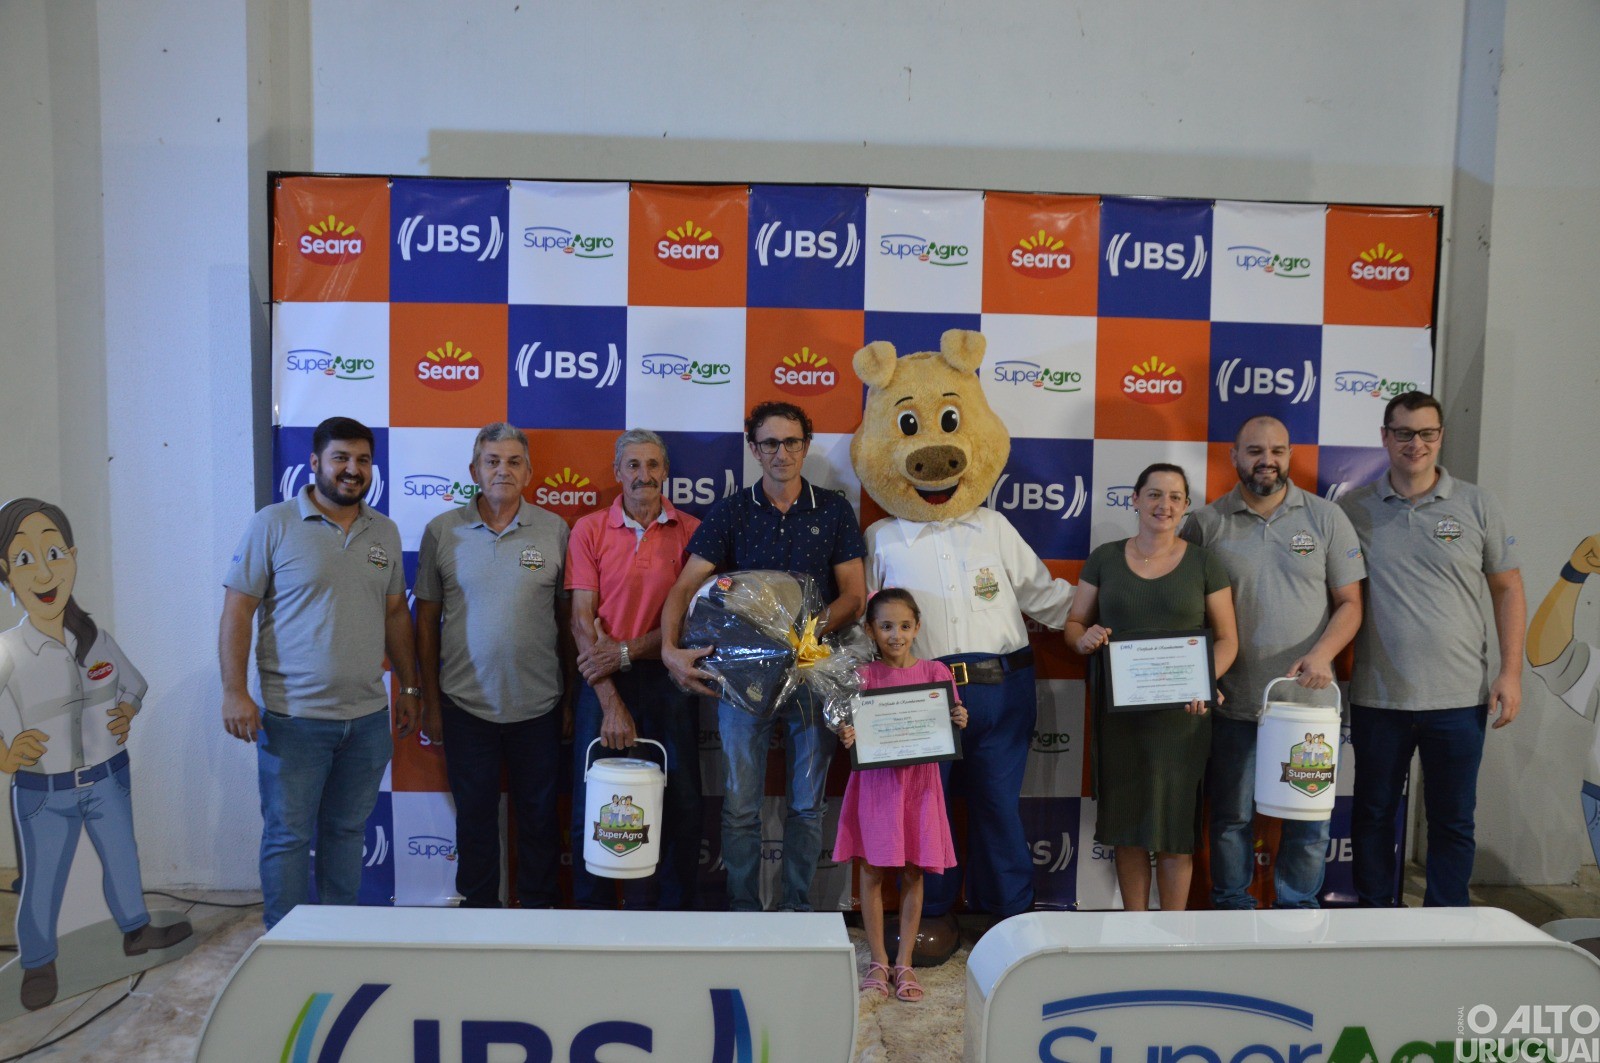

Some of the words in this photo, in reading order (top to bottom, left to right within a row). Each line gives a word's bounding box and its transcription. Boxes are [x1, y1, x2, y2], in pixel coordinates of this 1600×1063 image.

[300, 234, 362, 255] Seara
[416, 224, 481, 253] JBS
[524, 231, 614, 251] SuperAgro
[775, 230, 838, 259] JBS
[880, 239, 969, 258] SuperAgro
[657, 240, 719, 260] Seara
[1011, 249, 1071, 270] Seara
[1124, 242, 1185, 270] JBS
[1351, 261, 1410, 282] Seara
[286, 354, 375, 374] SuperAgro
[418, 361, 479, 381] Seara
[534, 351, 599, 379] JBS
[641, 358, 731, 378] SuperAgro
[774, 366, 836, 387] Seara
[994, 366, 1081, 387] SuperAgro
[1123, 375, 1183, 396] Seara
[1234, 367, 1295, 395] JBS
[1335, 376, 1418, 396] SuperAgro
[404, 480, 480, 499] SuperAgr
[536, 486, 597, 507] Seara
[1002, 483, 1065, 510] JBS
[1288, 769, 1332, 780] SuperAgro
[598, 828, 643, 841] SuperAgro
[1325, 838, 1353, 863] JB
